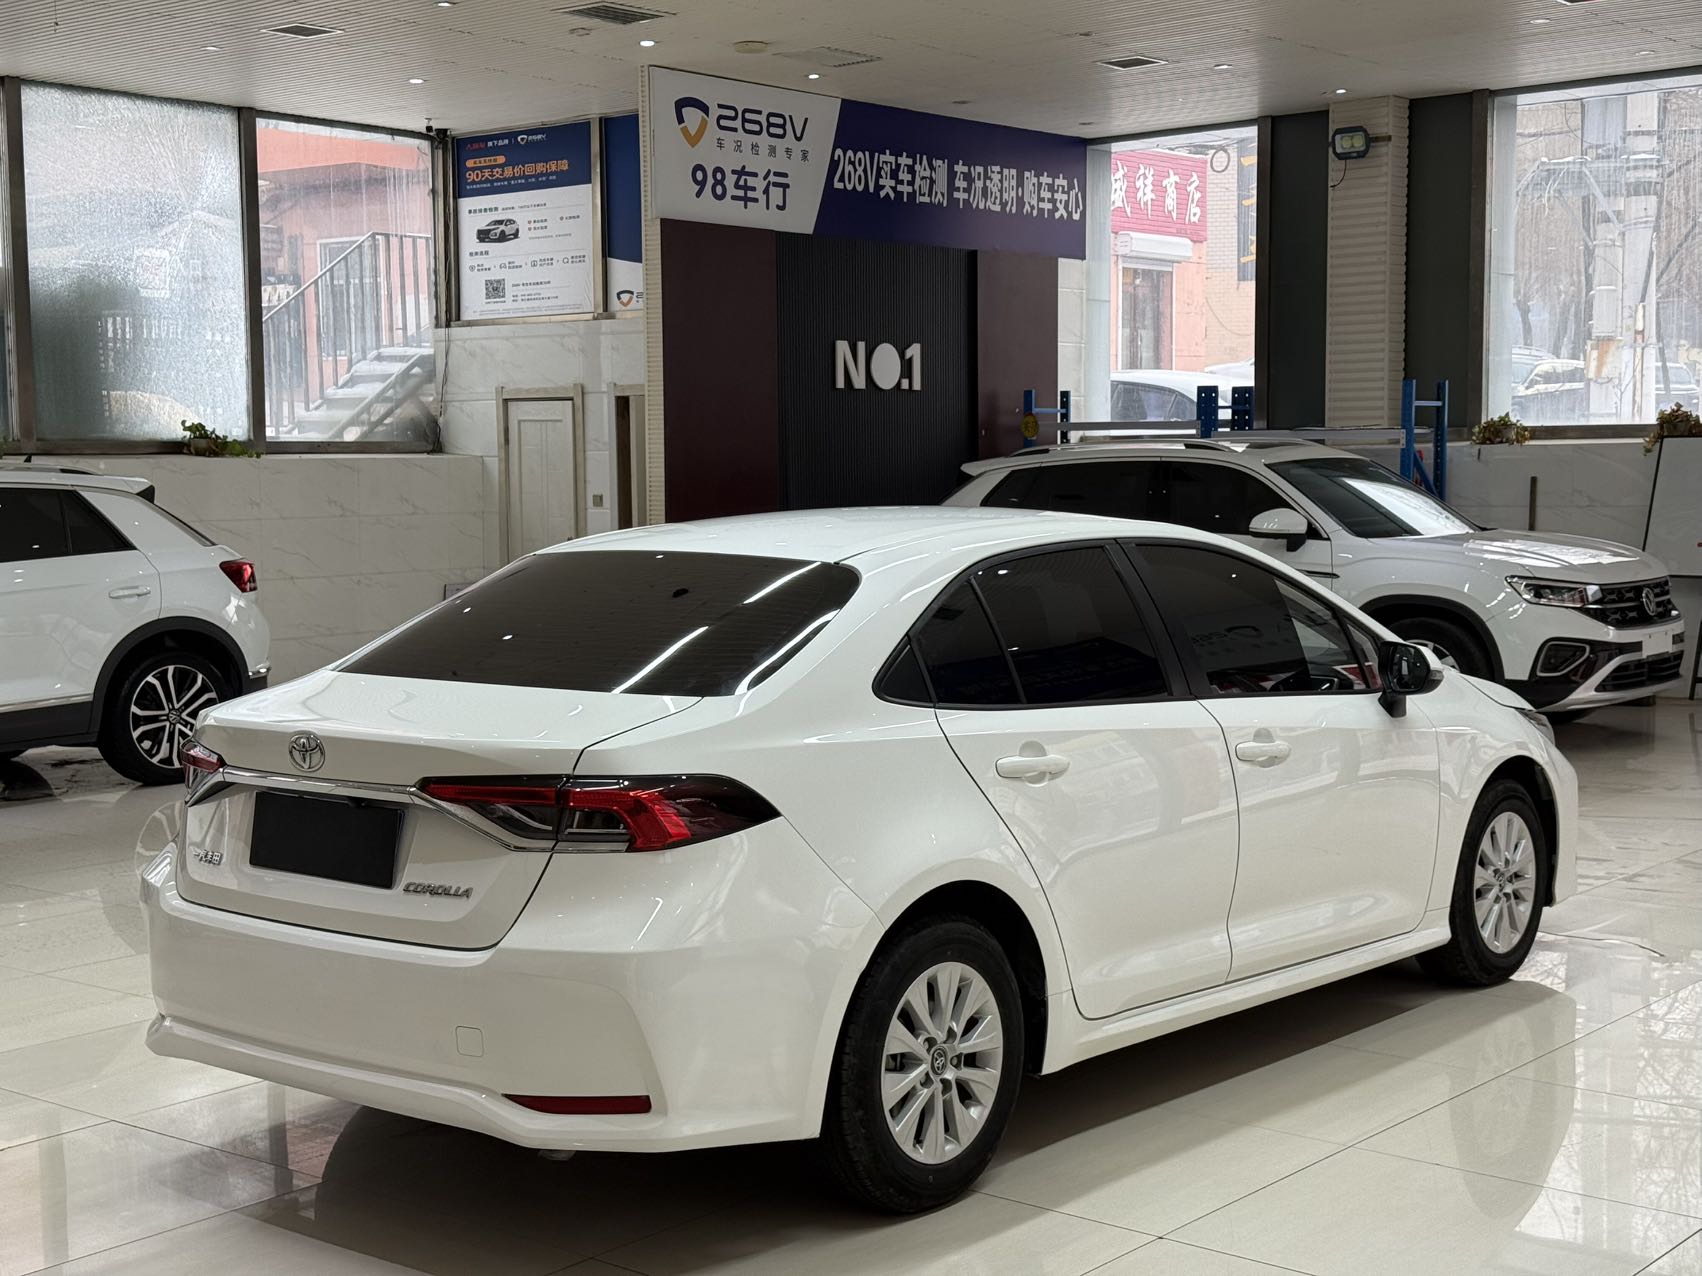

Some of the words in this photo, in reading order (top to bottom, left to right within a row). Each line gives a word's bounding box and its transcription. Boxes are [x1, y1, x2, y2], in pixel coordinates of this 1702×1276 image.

[716, 103, 809, 142] 268V
[716, 137, 810, 163] 车况检测专家
[465, 159, 569, 183] 90天交易价回购保障
[691, 163, 791, 212] 98车行
[833, 148, 948, 207] 268V实车检测
[835, 340, 921, 391] NO.1
[403, 882, 474, 899] COROLLA
